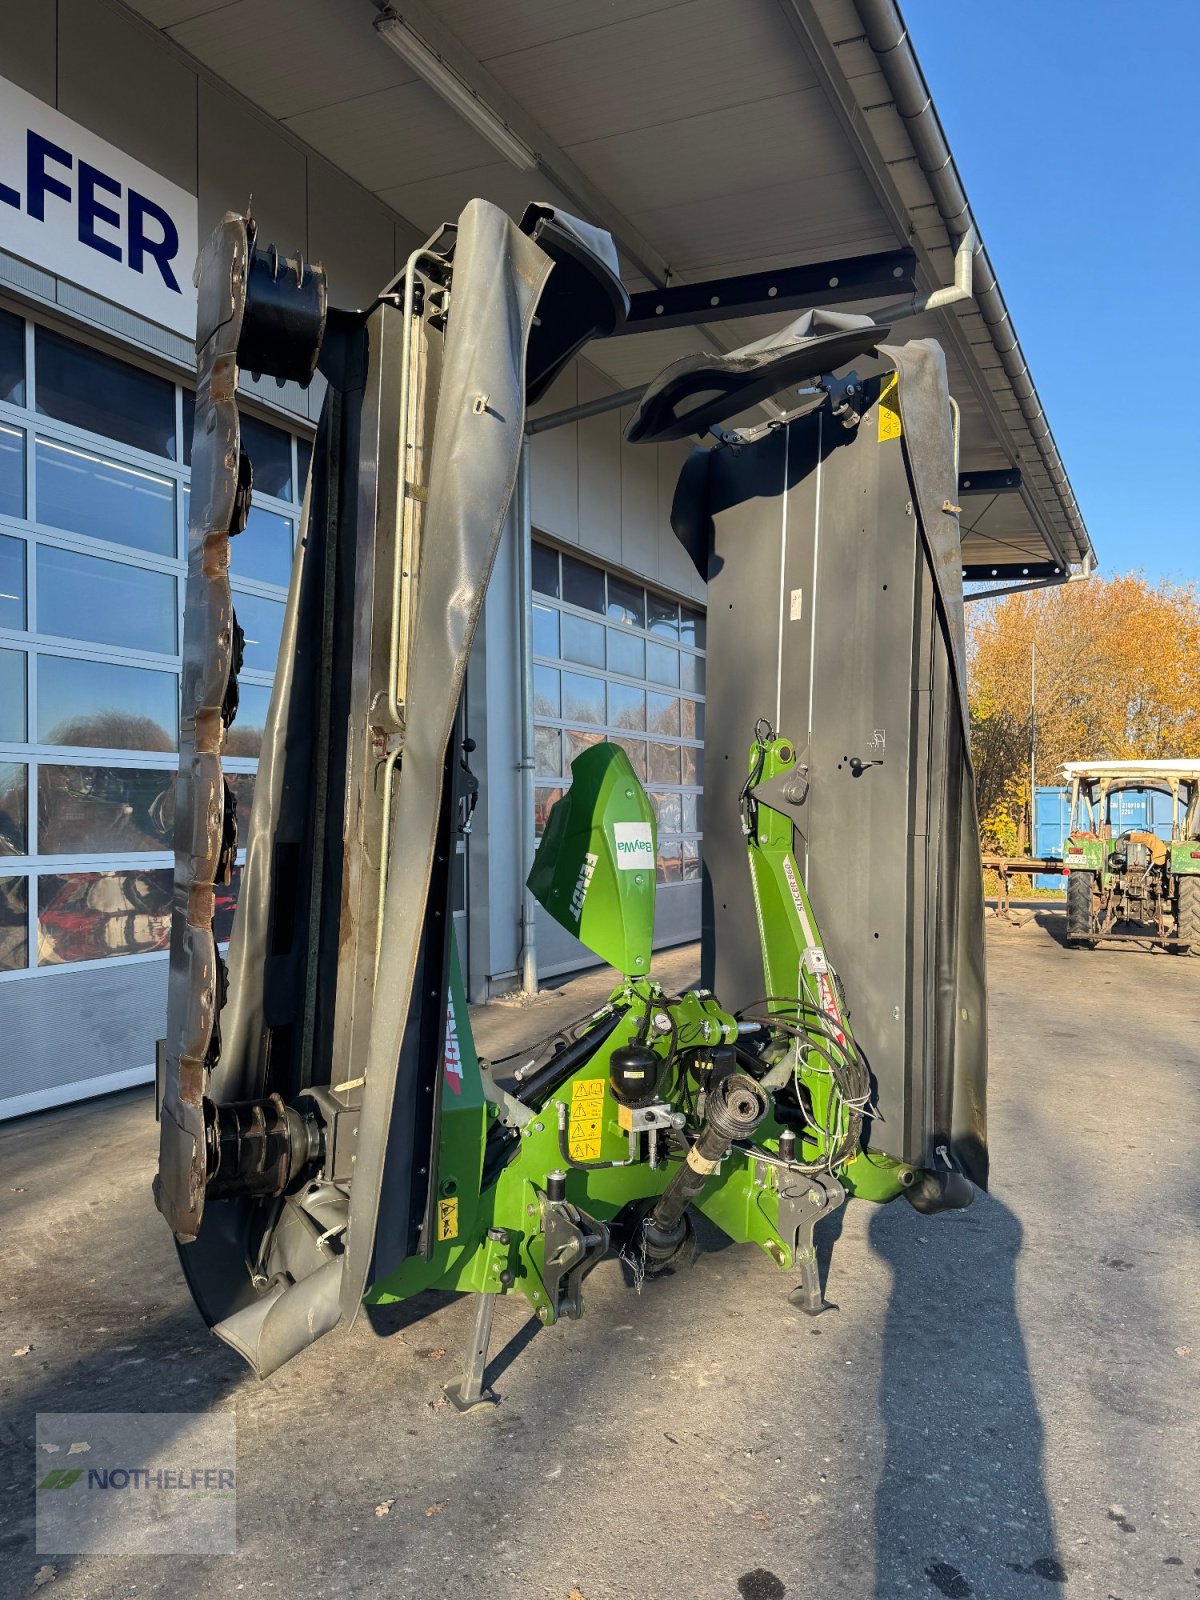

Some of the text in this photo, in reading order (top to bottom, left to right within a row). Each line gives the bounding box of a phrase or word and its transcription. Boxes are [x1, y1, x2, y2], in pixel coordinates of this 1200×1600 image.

[0, 128, 182, 295] FER
[617, 840, 652, 854] BayWa
[569, 852, 599, 923] FENDT
[789, 881, 805, 912] SLICER
